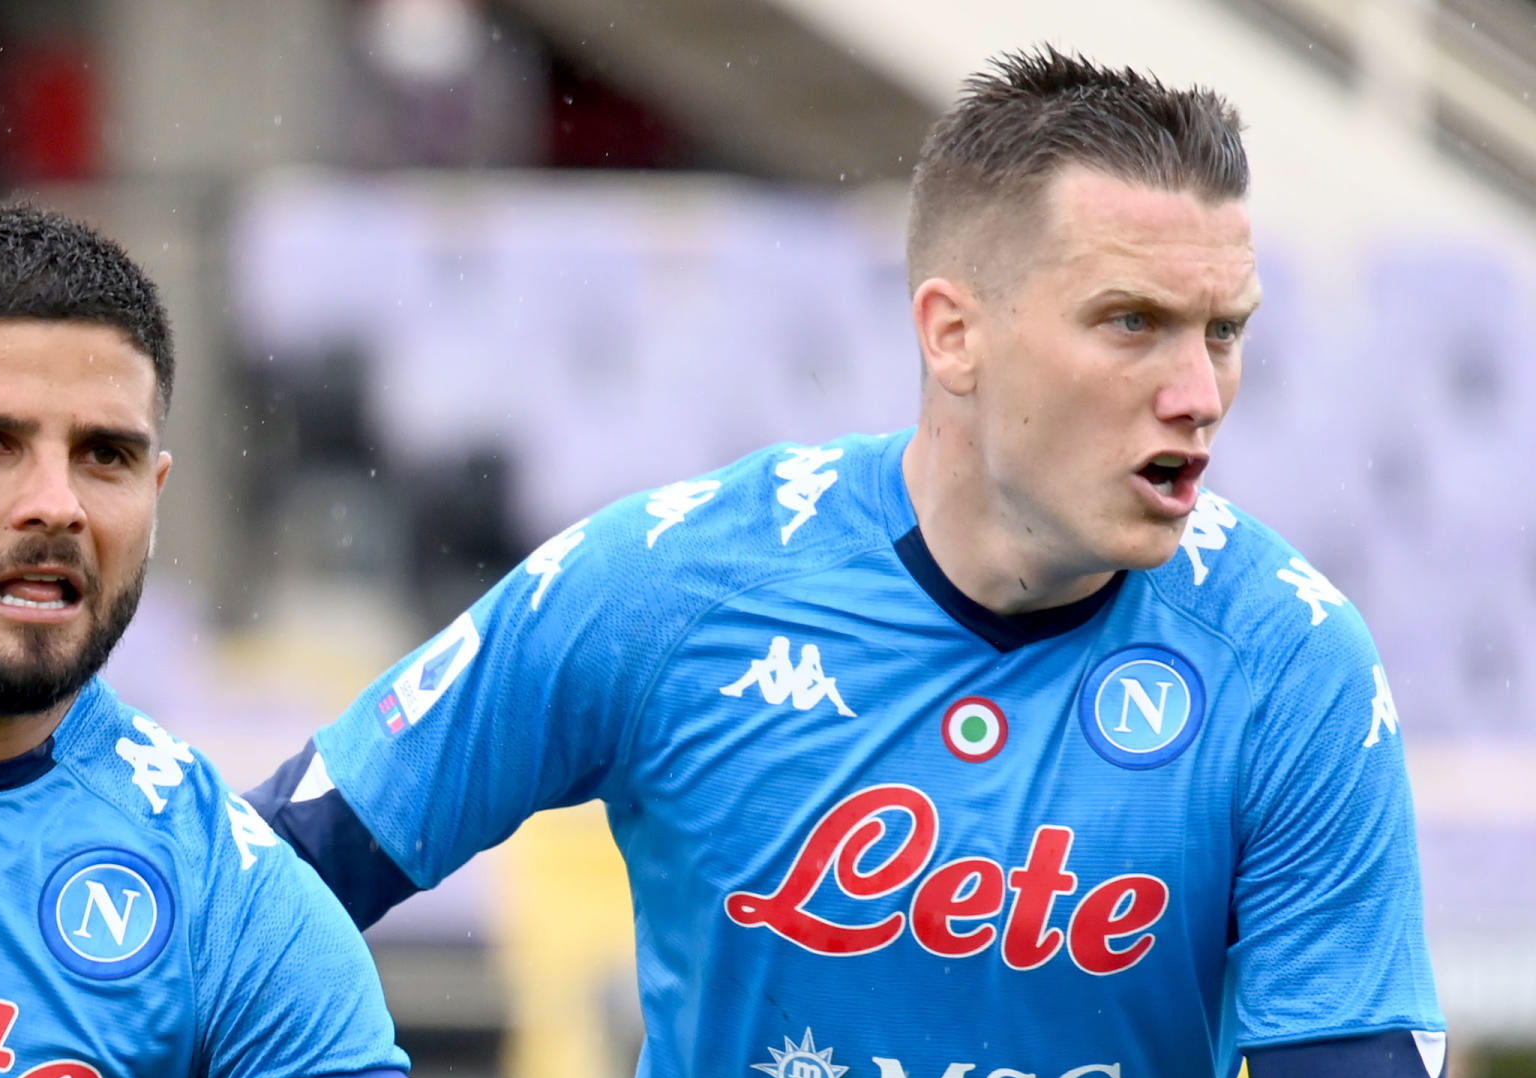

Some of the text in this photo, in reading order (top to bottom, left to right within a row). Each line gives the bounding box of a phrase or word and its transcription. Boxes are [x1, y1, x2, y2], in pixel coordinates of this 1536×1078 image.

[1113, 677, 1173, 734] N
[724, 783, 1169, 976] Lete
[73, 880, 141, 945] N
